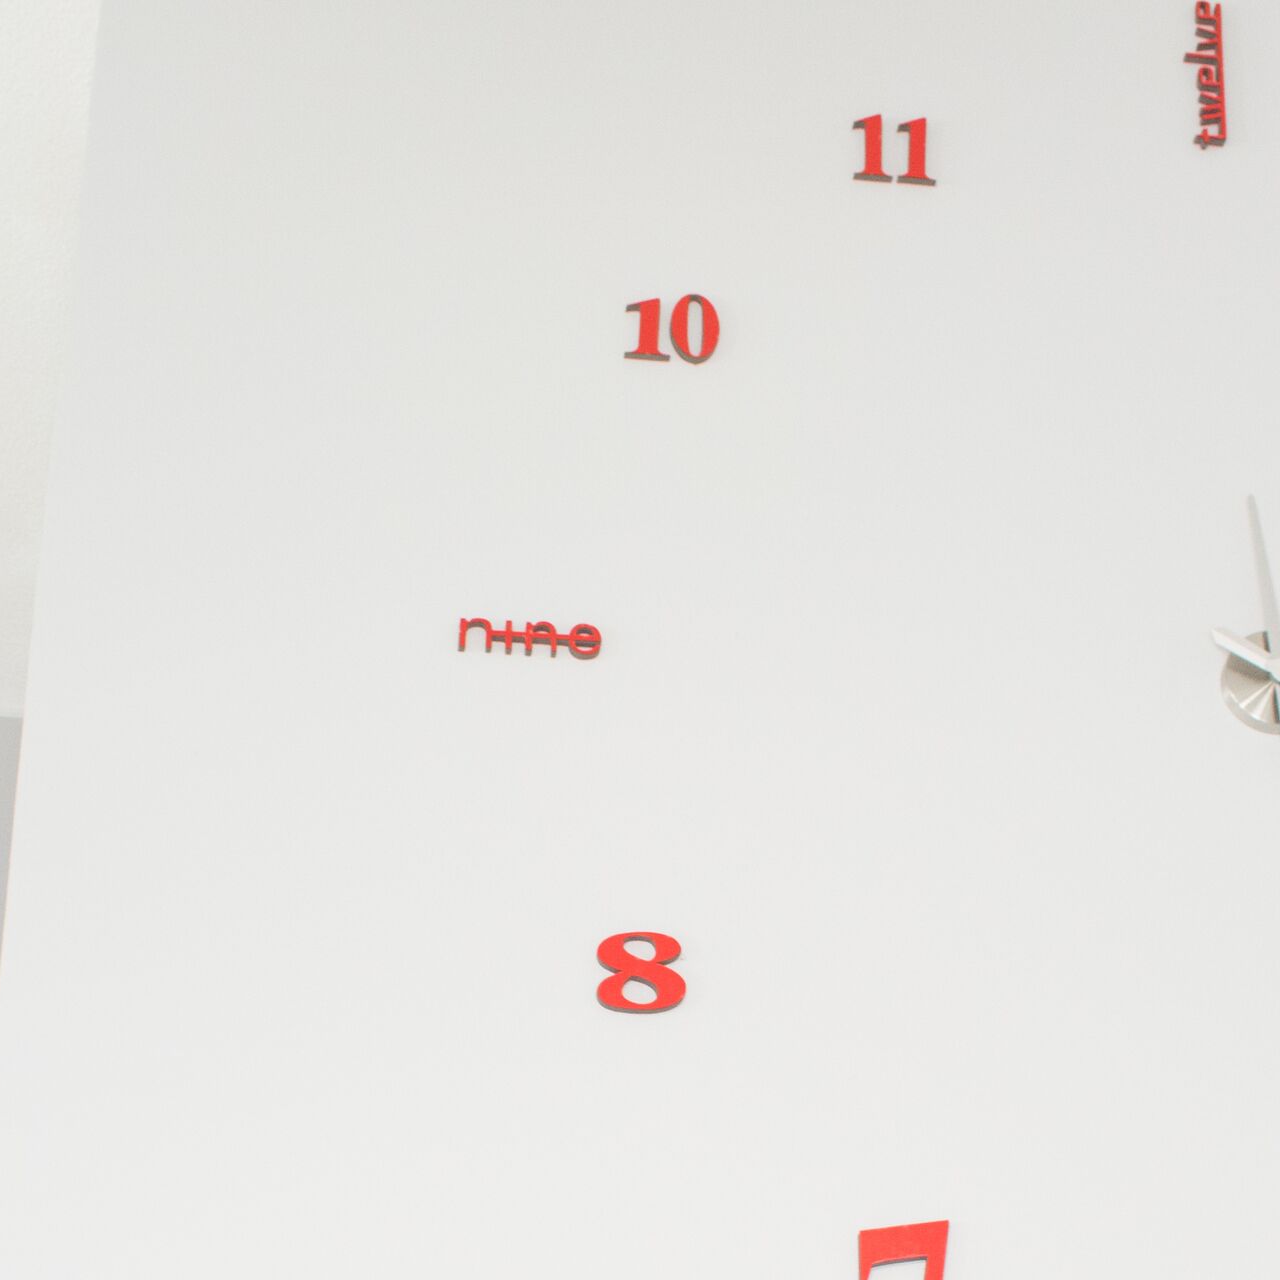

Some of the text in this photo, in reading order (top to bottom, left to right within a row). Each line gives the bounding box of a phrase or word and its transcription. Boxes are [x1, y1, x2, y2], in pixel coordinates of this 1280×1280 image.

[1184, 0, 1227, 149] twelve
[852, 113, 936, 187] 11
[624, 294, 721, 366] 10
[458, 616, 603, 661] nine
[596, 931, 687, 1014] 8
